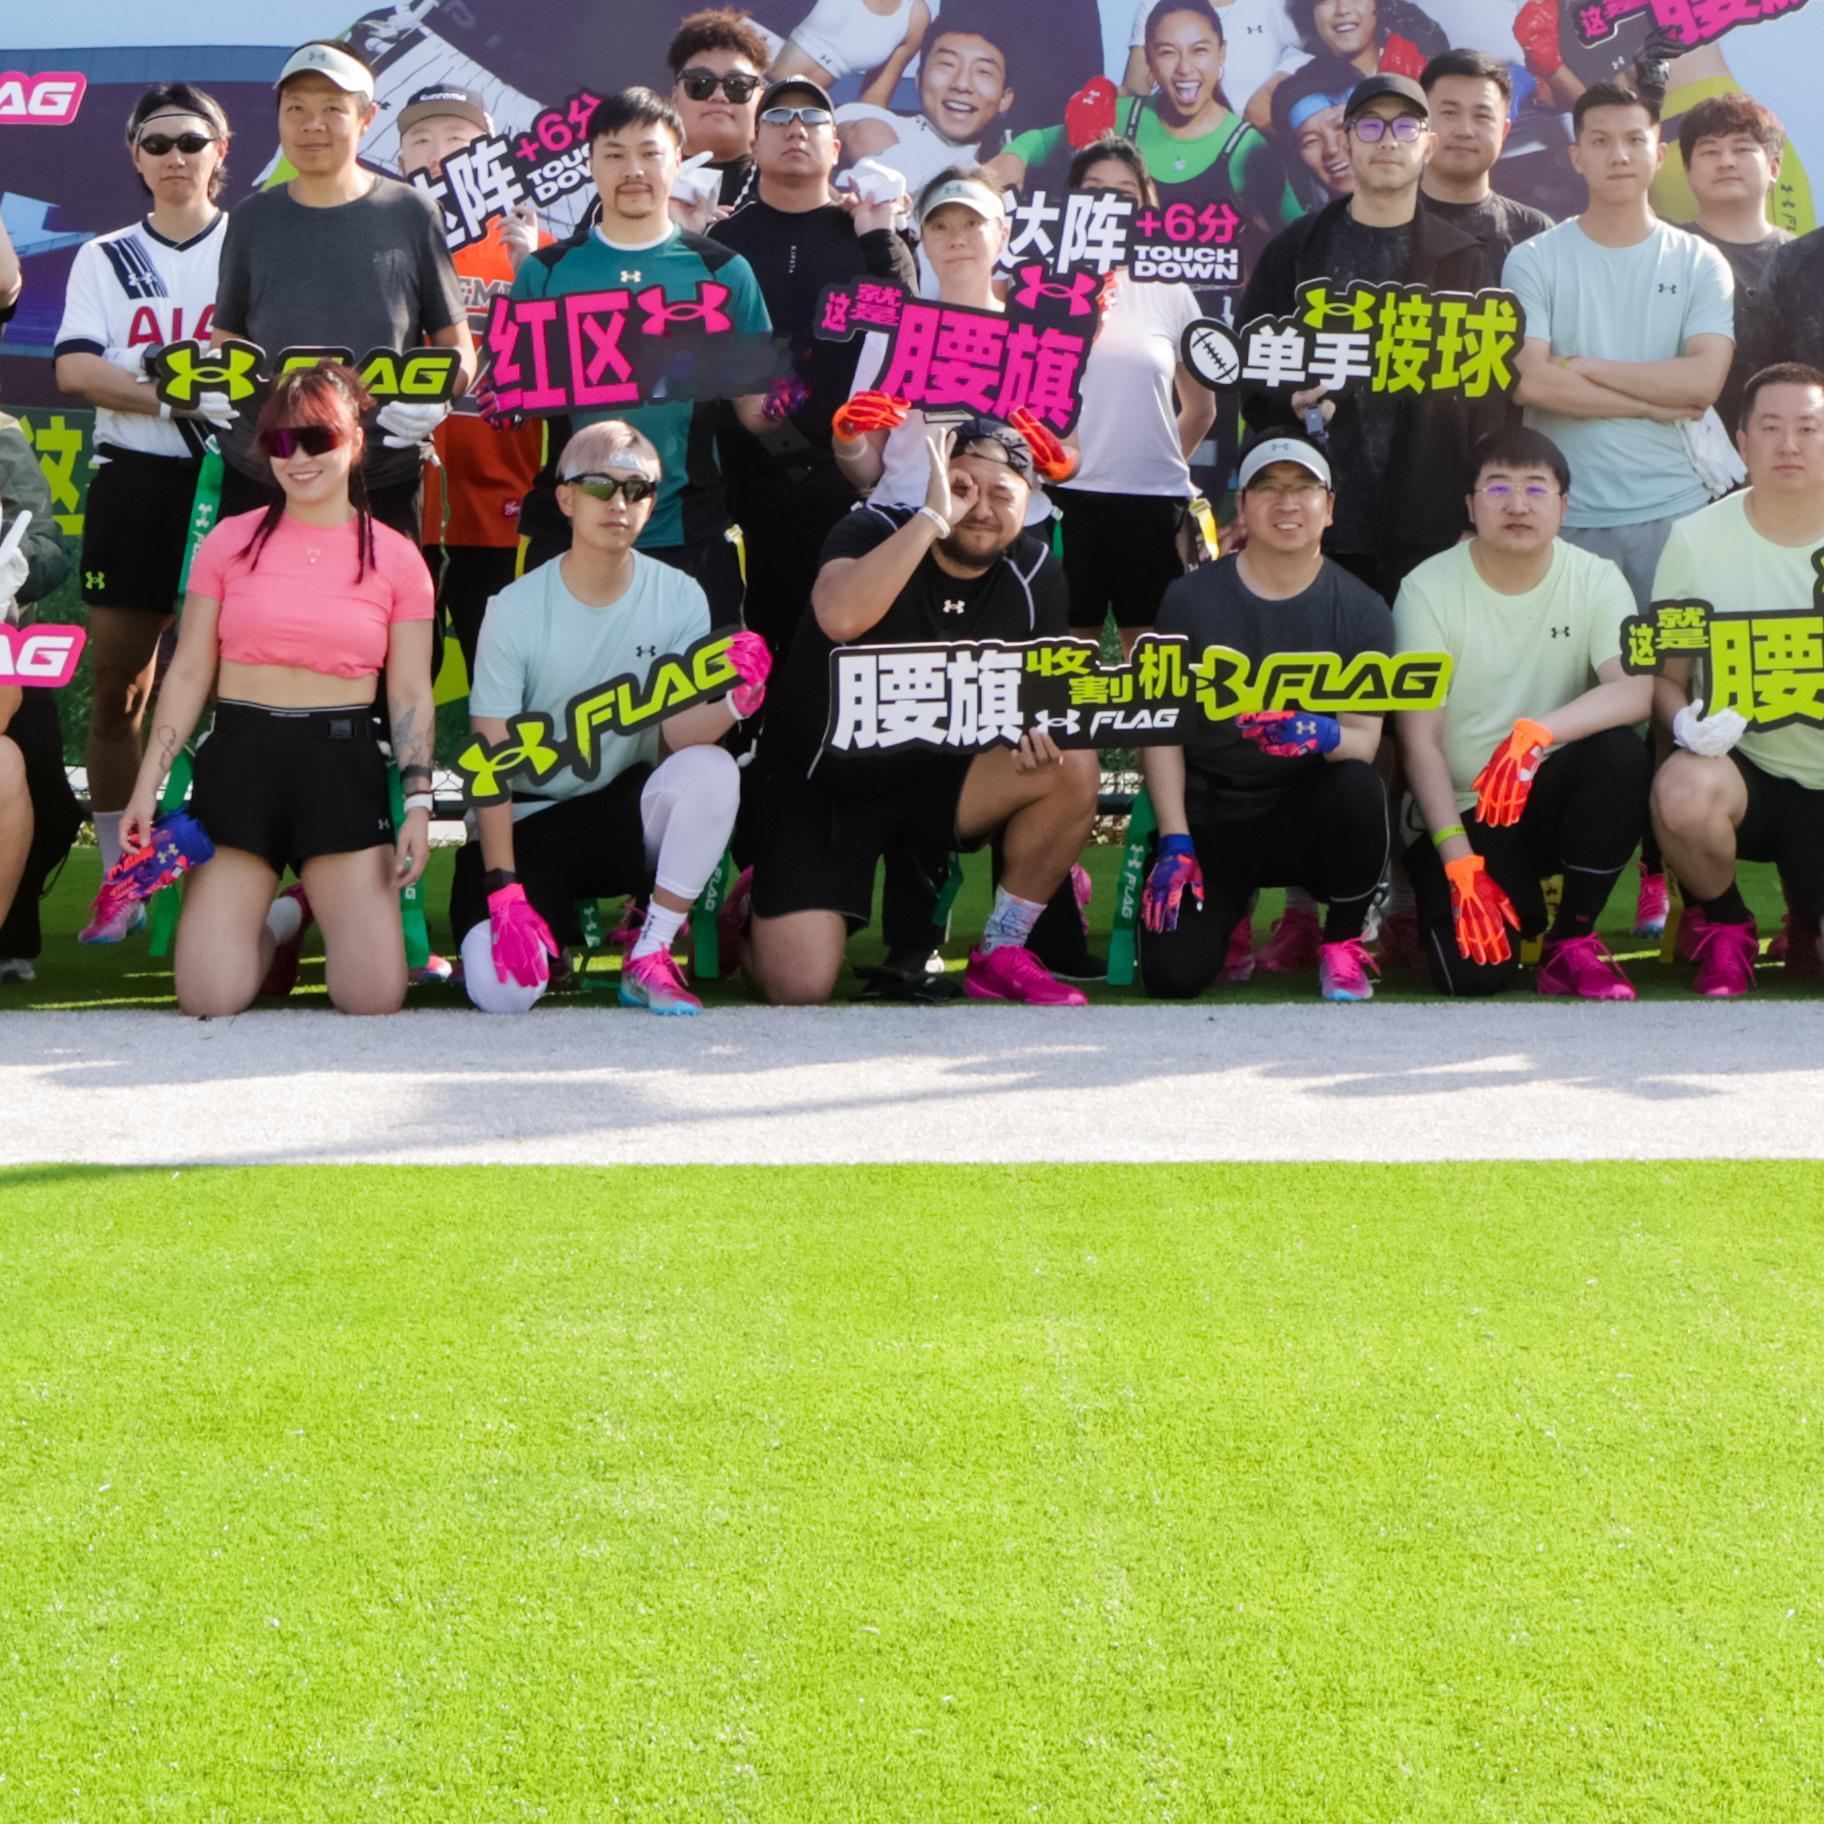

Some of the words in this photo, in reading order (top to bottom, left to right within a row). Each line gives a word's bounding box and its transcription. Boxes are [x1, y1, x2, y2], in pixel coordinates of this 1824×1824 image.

[527, 142, 591, 185] TOU
[534, 160, 593, 202] DO
[997, 192, 1134, 275] 达阵
[1135, 202, 1240, 244] +6分
[1133, 245, 1238, 264] TOUCH
[1133, 260, 1238, 280] DOWN
[487, 290, 639, 411] 红区
[1241, 291, 1518, 398] 单手接球
[284, 356, 452, 395] FAG
[575, 637, 736, 767] FLAG
[829, 642, 1188, 750] 腰旗收割机
[1276, 661, 1444, 708] FLAG
[1089, 708, 1180, 735] FLAG
[1121, 870, 1138, 910] FLAG
